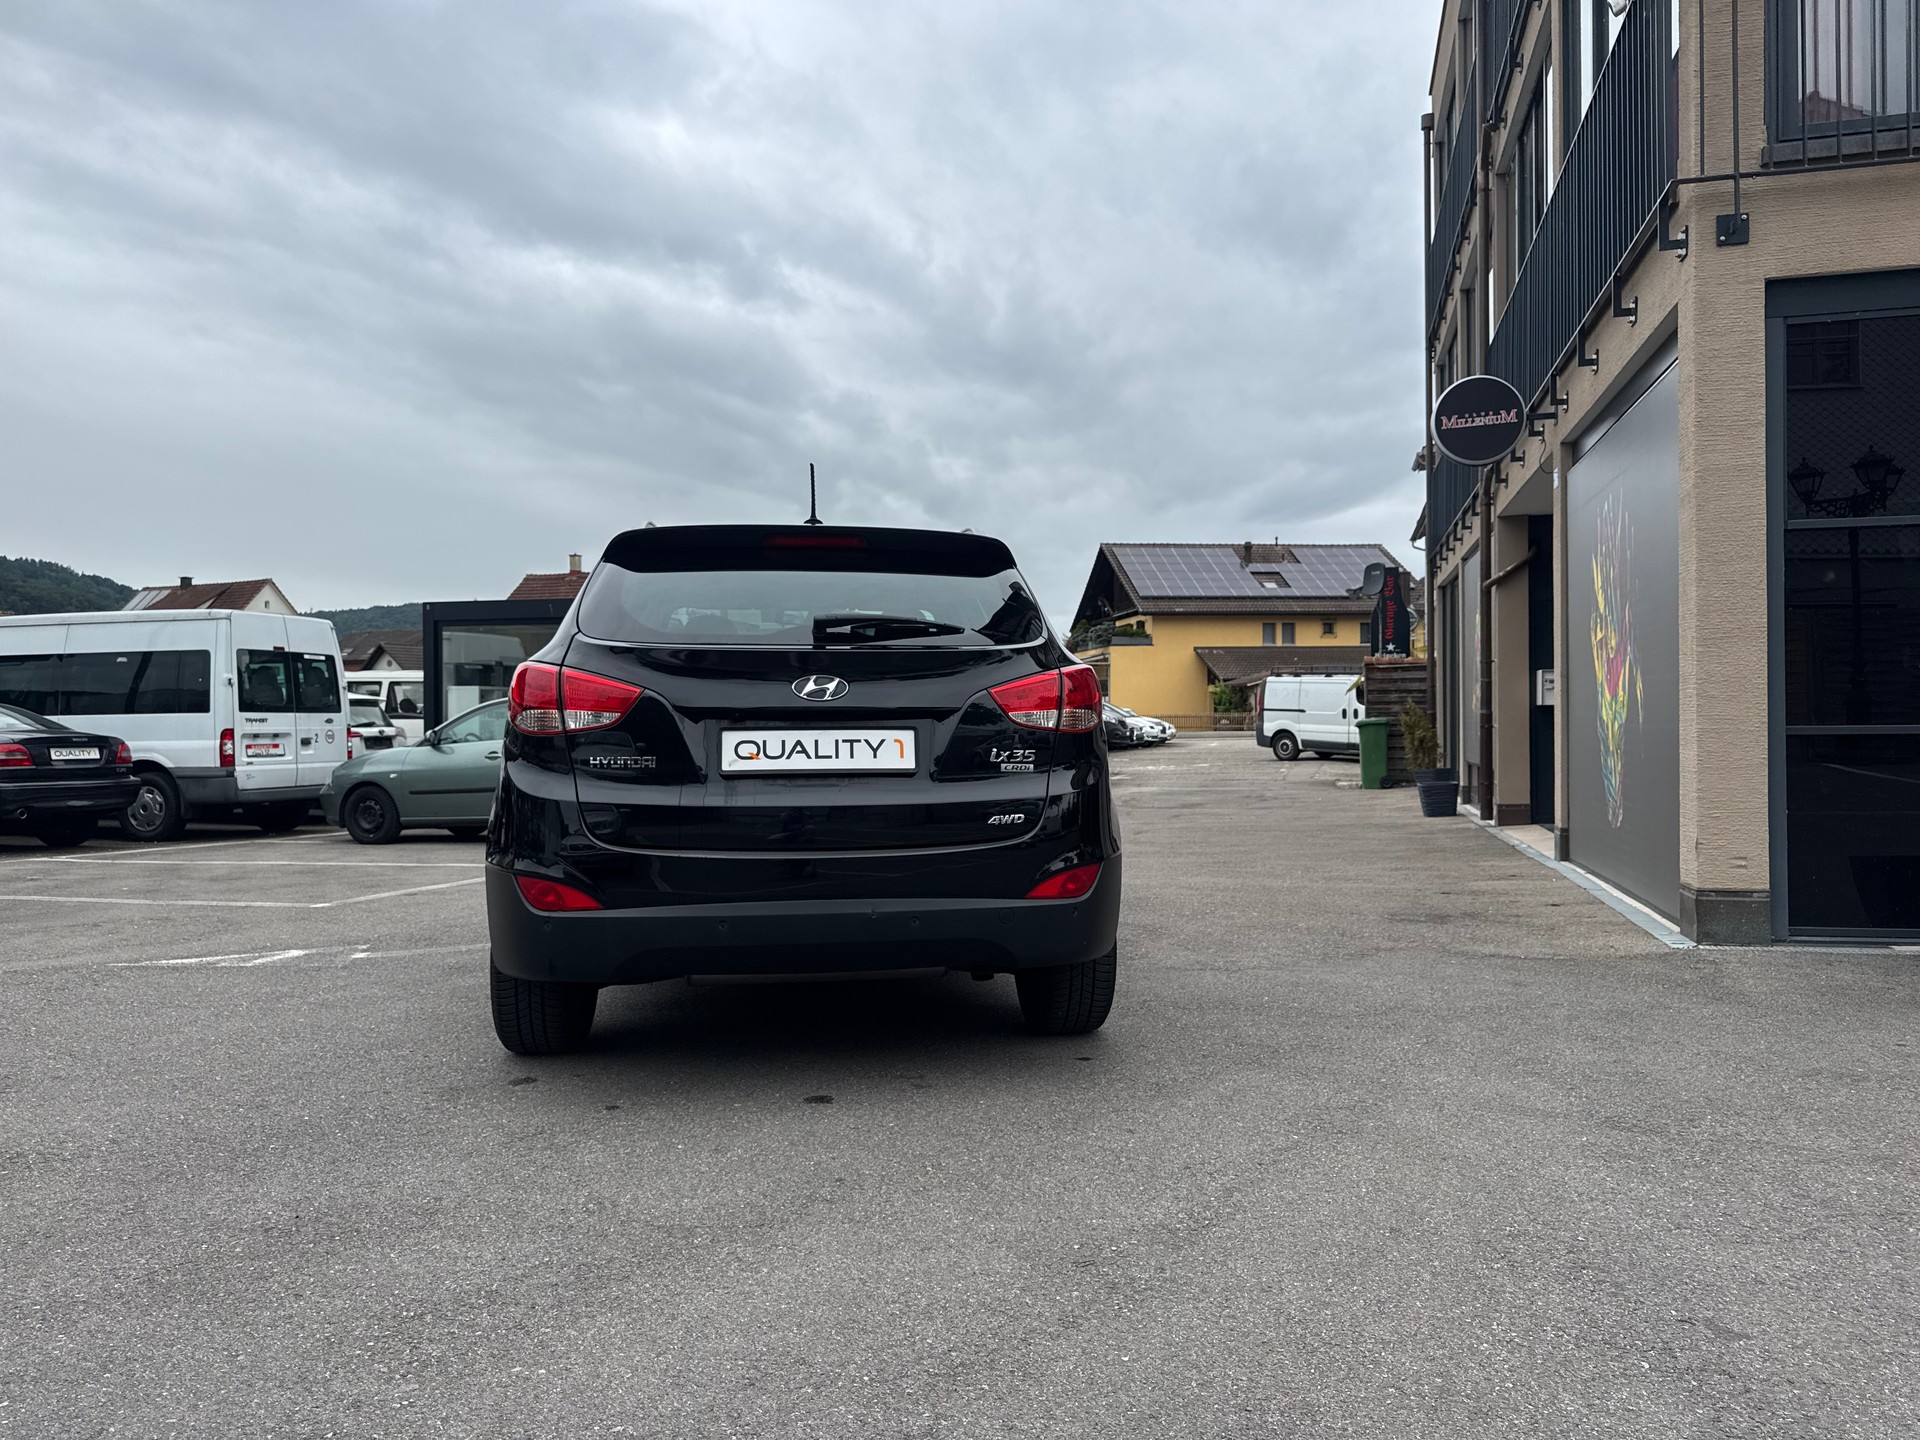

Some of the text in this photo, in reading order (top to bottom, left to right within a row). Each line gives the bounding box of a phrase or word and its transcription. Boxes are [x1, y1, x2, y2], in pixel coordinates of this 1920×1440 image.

[1383, 575, 1395, 597] Bar
[1384, 600, 1396, 639] Garage
[314, 732, 319, 743] 2
[734, 738, 905, 761] QUALITY 1
[989, 748, 1036, 762] ix35
[589, 756, 656, 768] HYUNDAI
[988, 814, 1025, 825] 4WD
